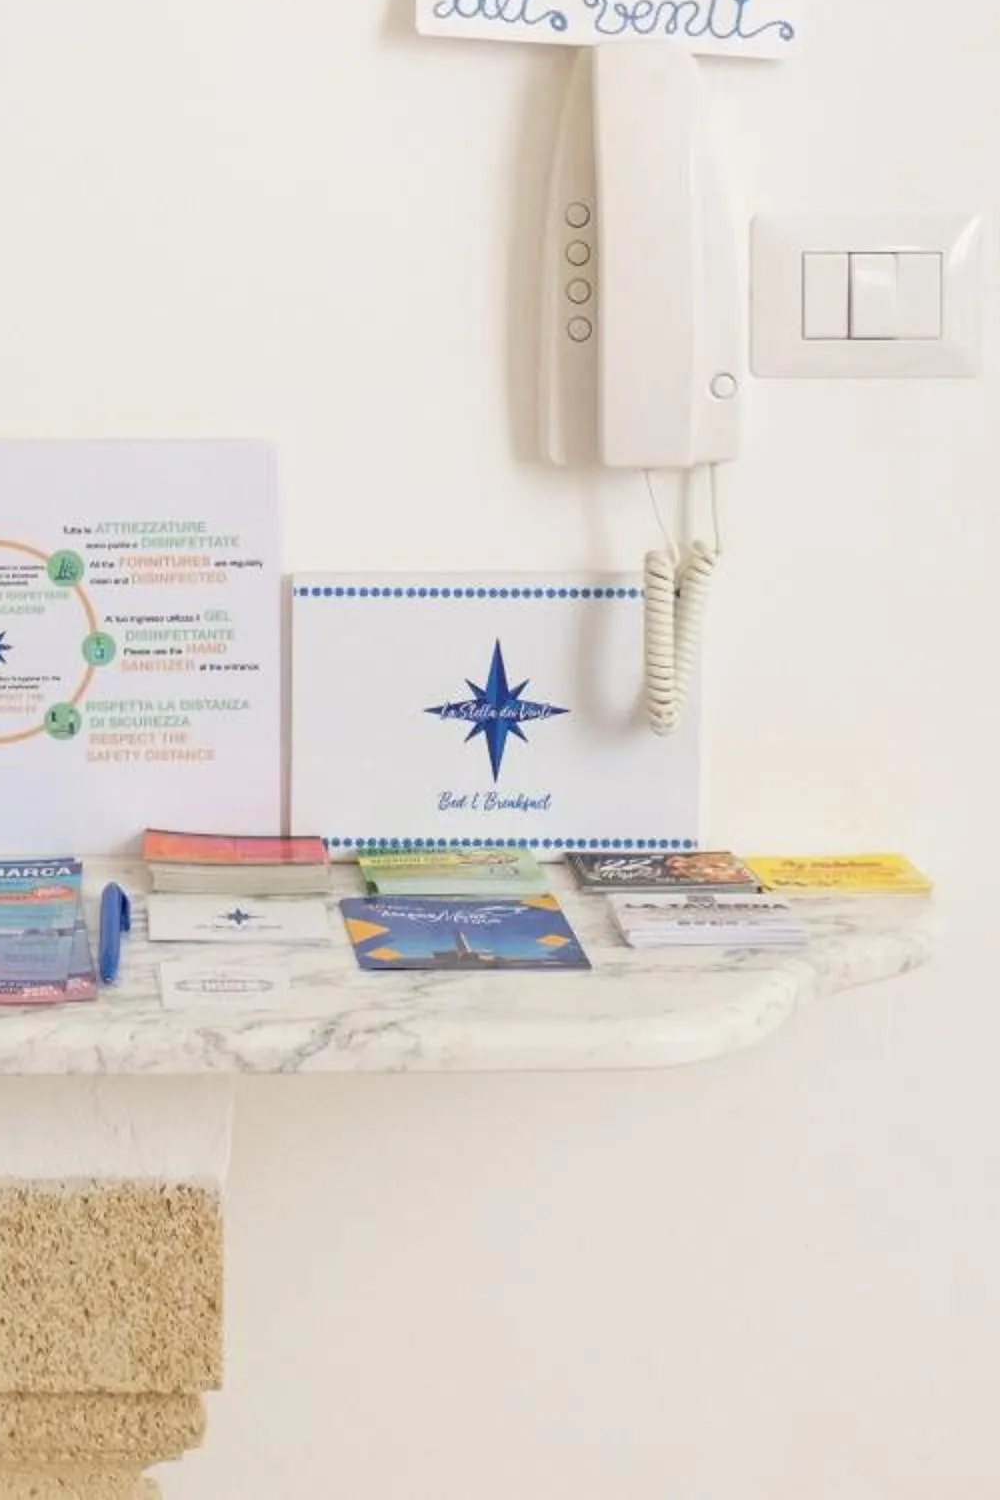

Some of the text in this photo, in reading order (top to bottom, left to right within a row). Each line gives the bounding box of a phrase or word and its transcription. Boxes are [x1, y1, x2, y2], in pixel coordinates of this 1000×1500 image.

[94, 521, 208, 534] ATTREZZATURE
[141, 535, 241, 549] DISINFETTATE
[131, 571, 228, 583] DISINFECTED
[203, 609, 233, 622] GEL
[125, 629, 235, 642] DISINFETTANTE
[185, 643, 228, 655] HAND
[120, 659, 196, 672] SANITIZER
[85, 698, 250, 712] RISPETTA LA DISTANZA
[441, 702, 551, 720] La Stella dei Venti
[89, 716, 191, 728] DI SICUREZZA
[89, 732, 188, 745] RESPECT THE
[86, 748, 216, 762] SAFETY DISTANCE
[438, 791, 467, 811] Bed
[483, 791, 552, 812] Breakfast
